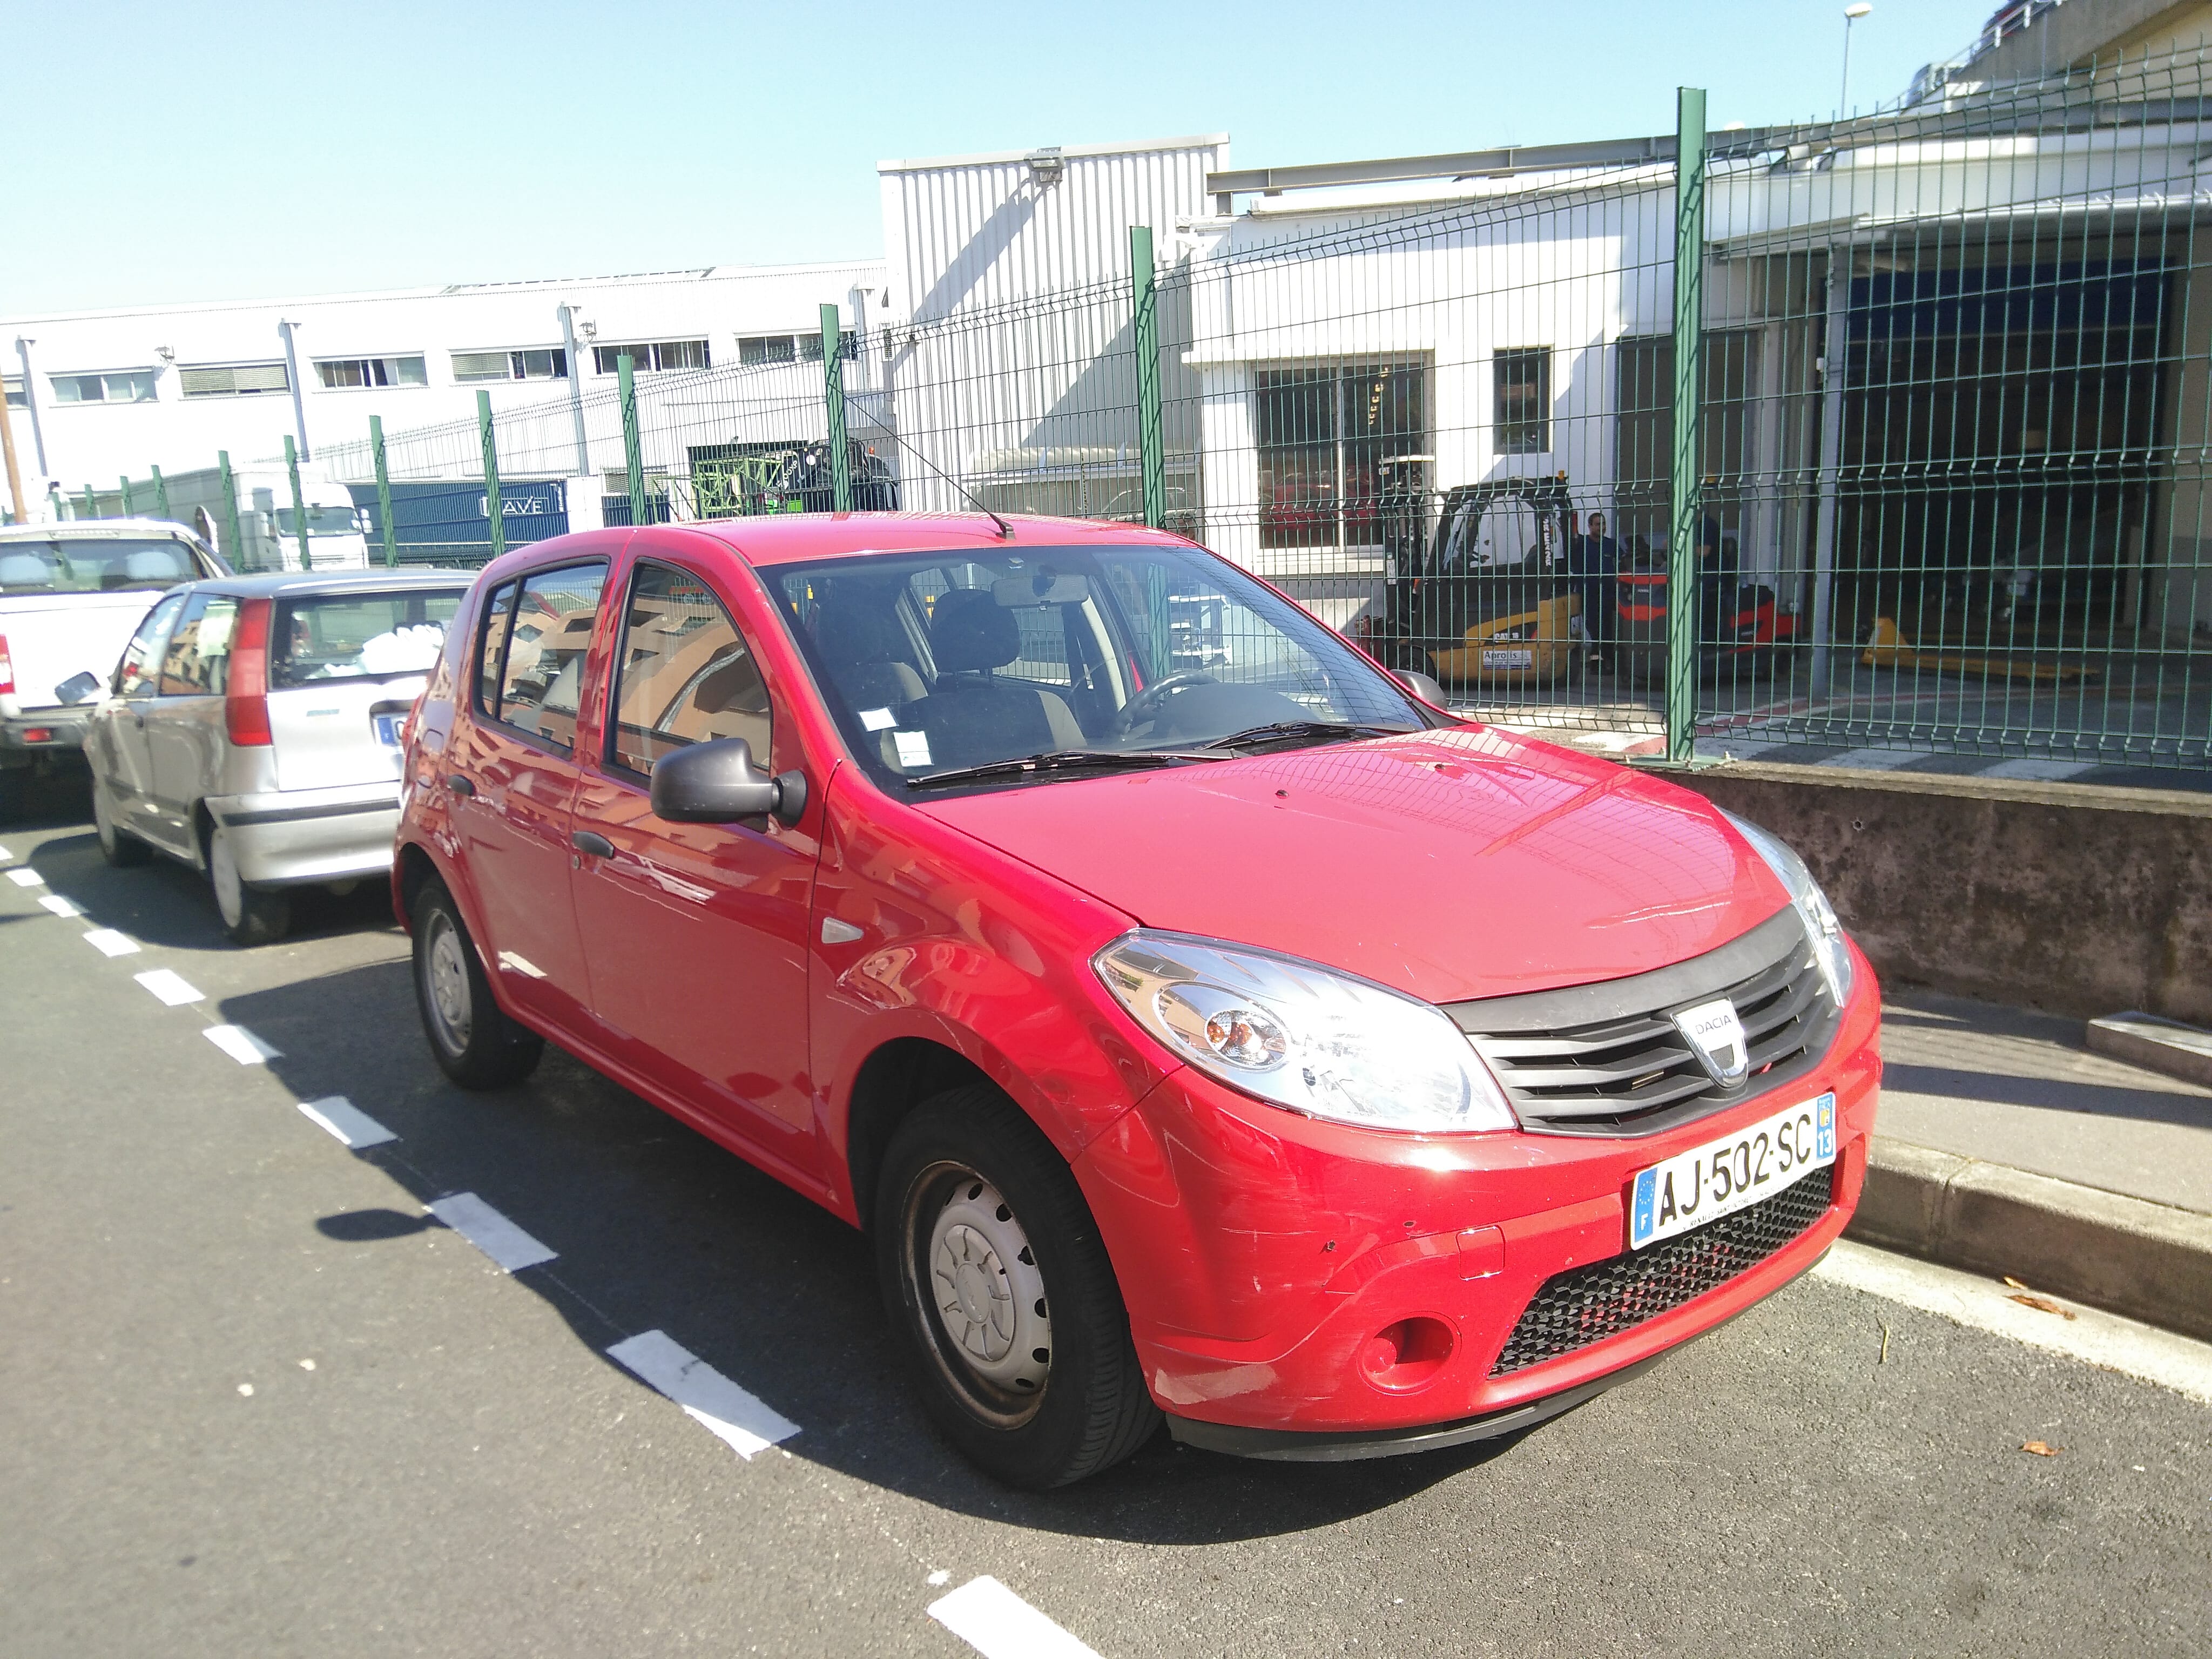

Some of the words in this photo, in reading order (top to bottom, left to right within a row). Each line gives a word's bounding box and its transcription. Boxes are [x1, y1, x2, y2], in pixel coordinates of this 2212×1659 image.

[1484, 651, 1517, 660] Aprois
[1696, 1015, 1731, 1034] DACIA
[1818, 1129, 1832, 1156] 13
[1659, 1114, 1811, 1227] AJ-502-SC
[1641, 1213, 1649, 1231] F
